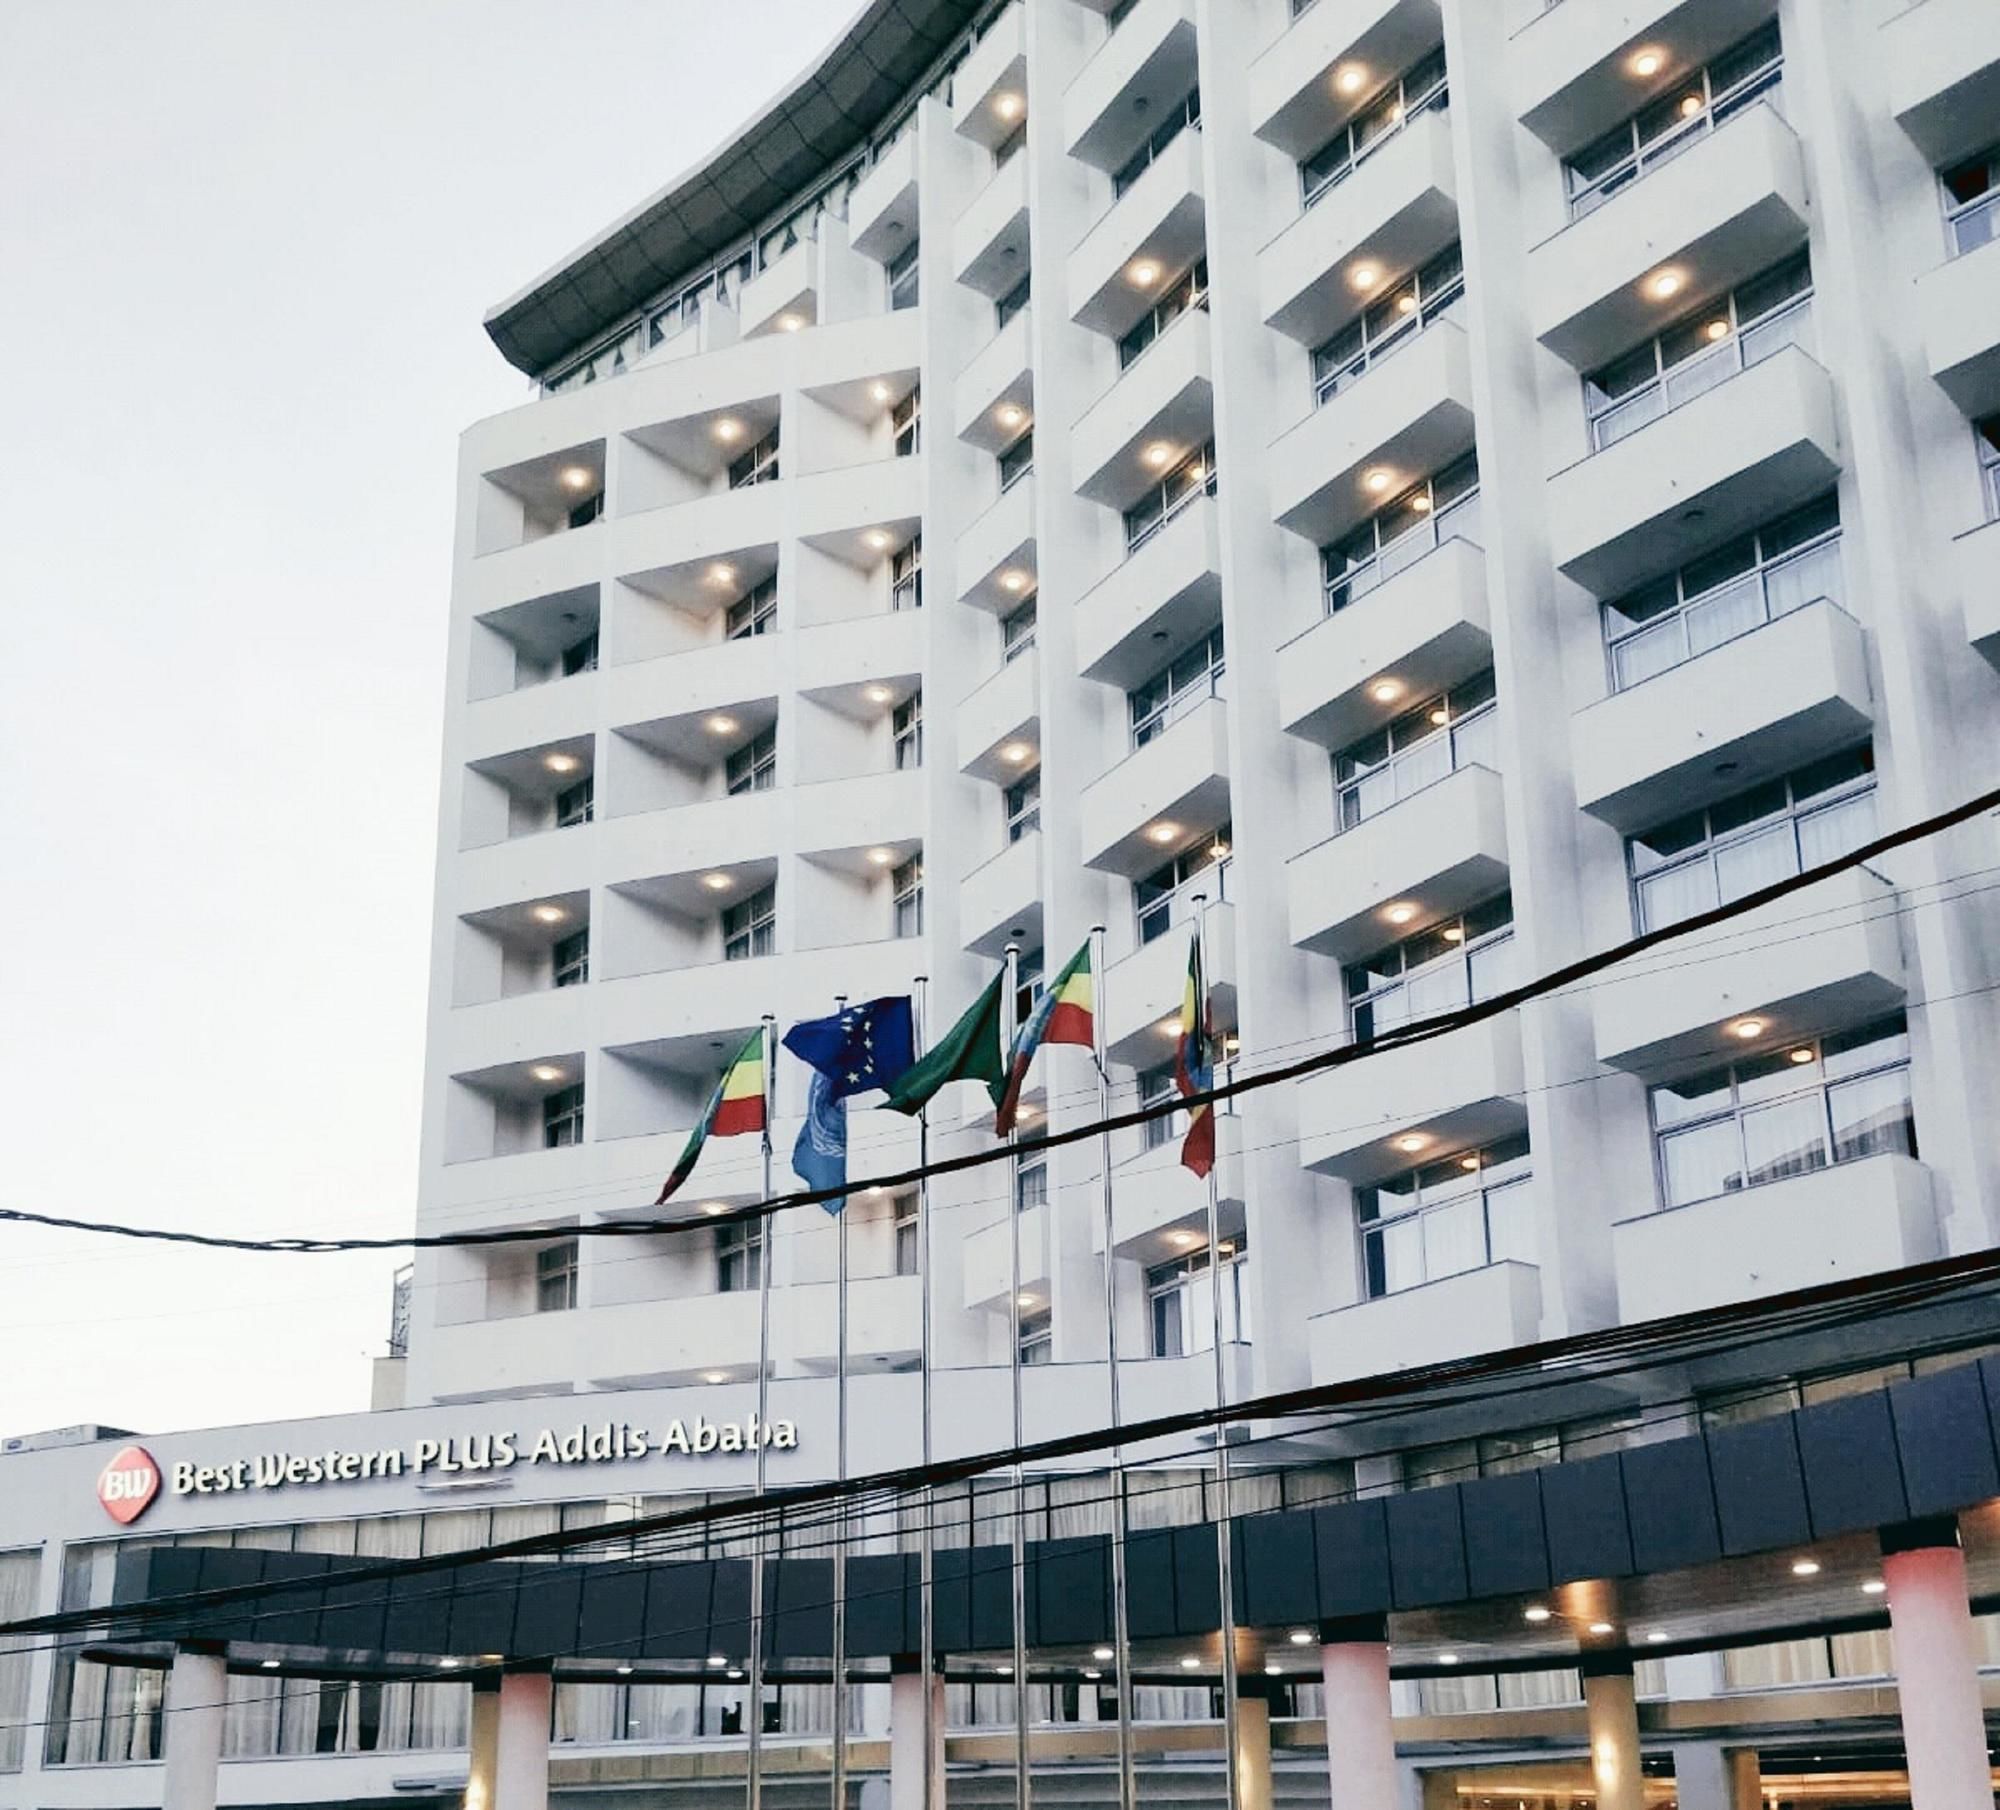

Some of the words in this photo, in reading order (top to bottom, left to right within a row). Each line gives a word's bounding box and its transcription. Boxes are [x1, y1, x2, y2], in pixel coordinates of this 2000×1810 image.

[172, 1460, 247, 1495] Best
[254, 1448, 403, 1488] Western
[413, 1431, 517, 1473] PLUS
[529, 1423, 648, 1464] Addis
[660, 1412, 798, 1455] Ababa
[104, 1469, 150, 1501] BW
